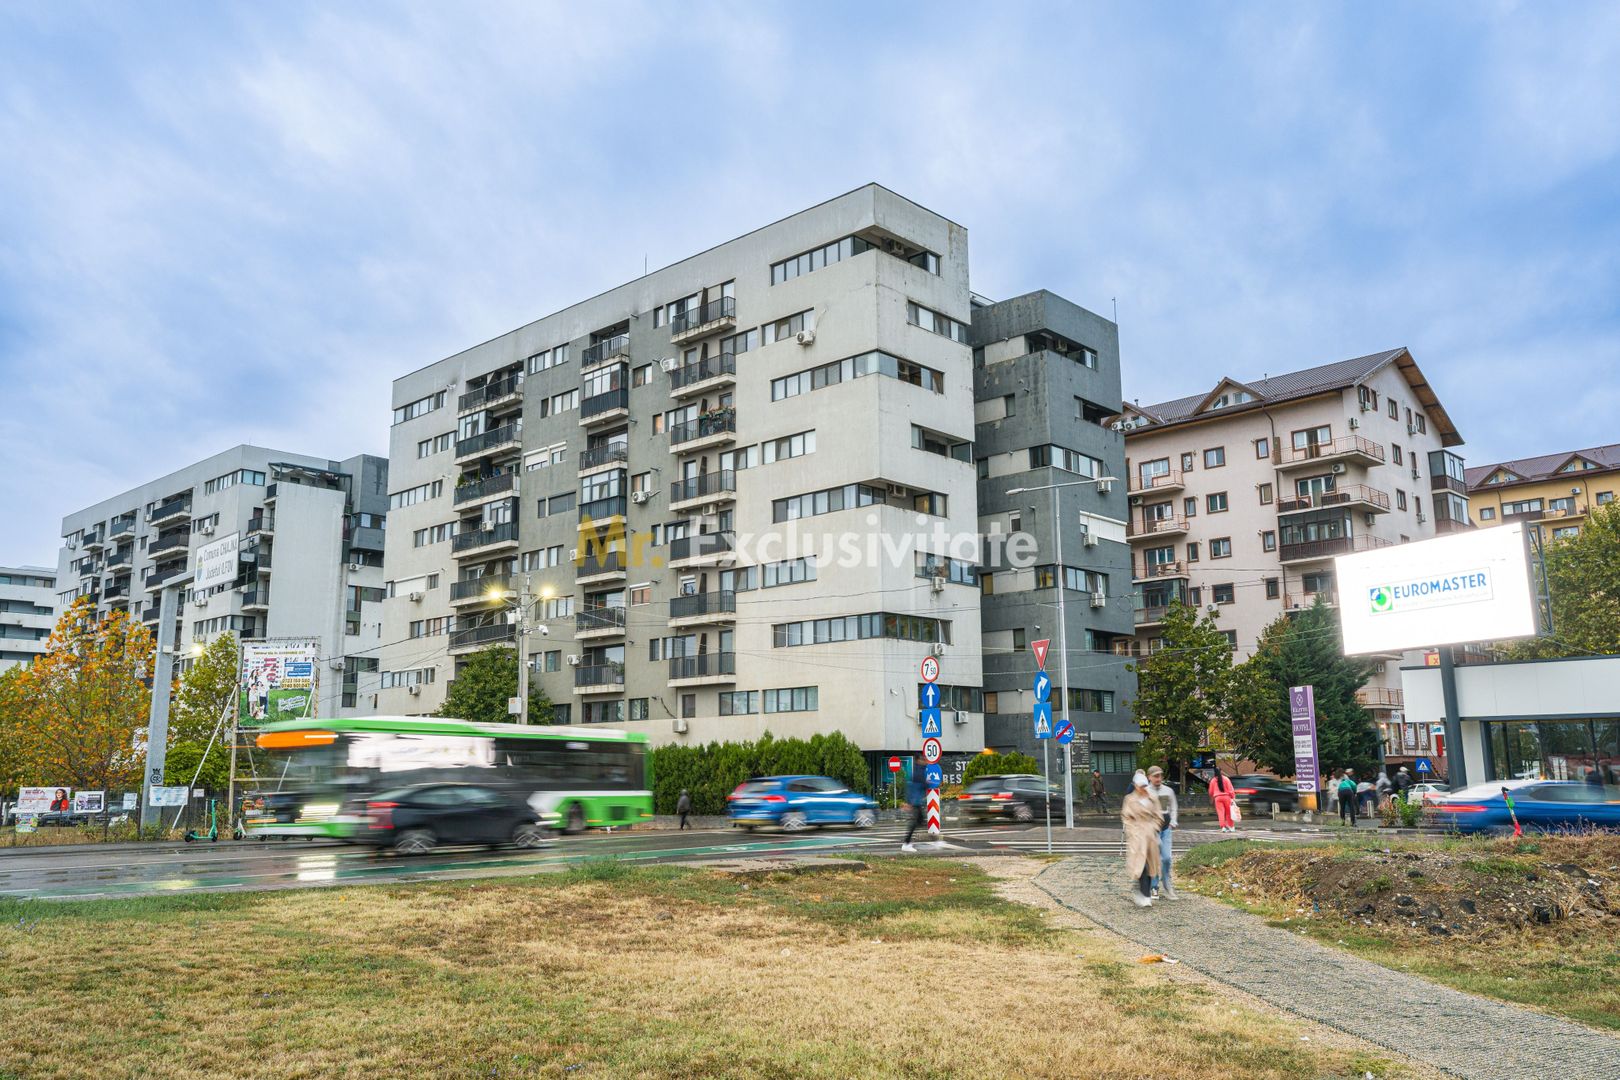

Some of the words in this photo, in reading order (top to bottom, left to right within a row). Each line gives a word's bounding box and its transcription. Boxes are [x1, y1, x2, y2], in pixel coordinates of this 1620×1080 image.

[1393, 572, 1487, 599] EUROMASTER
[926, 744, 938, 757] 50
[955, 760, 970, 771] ST
